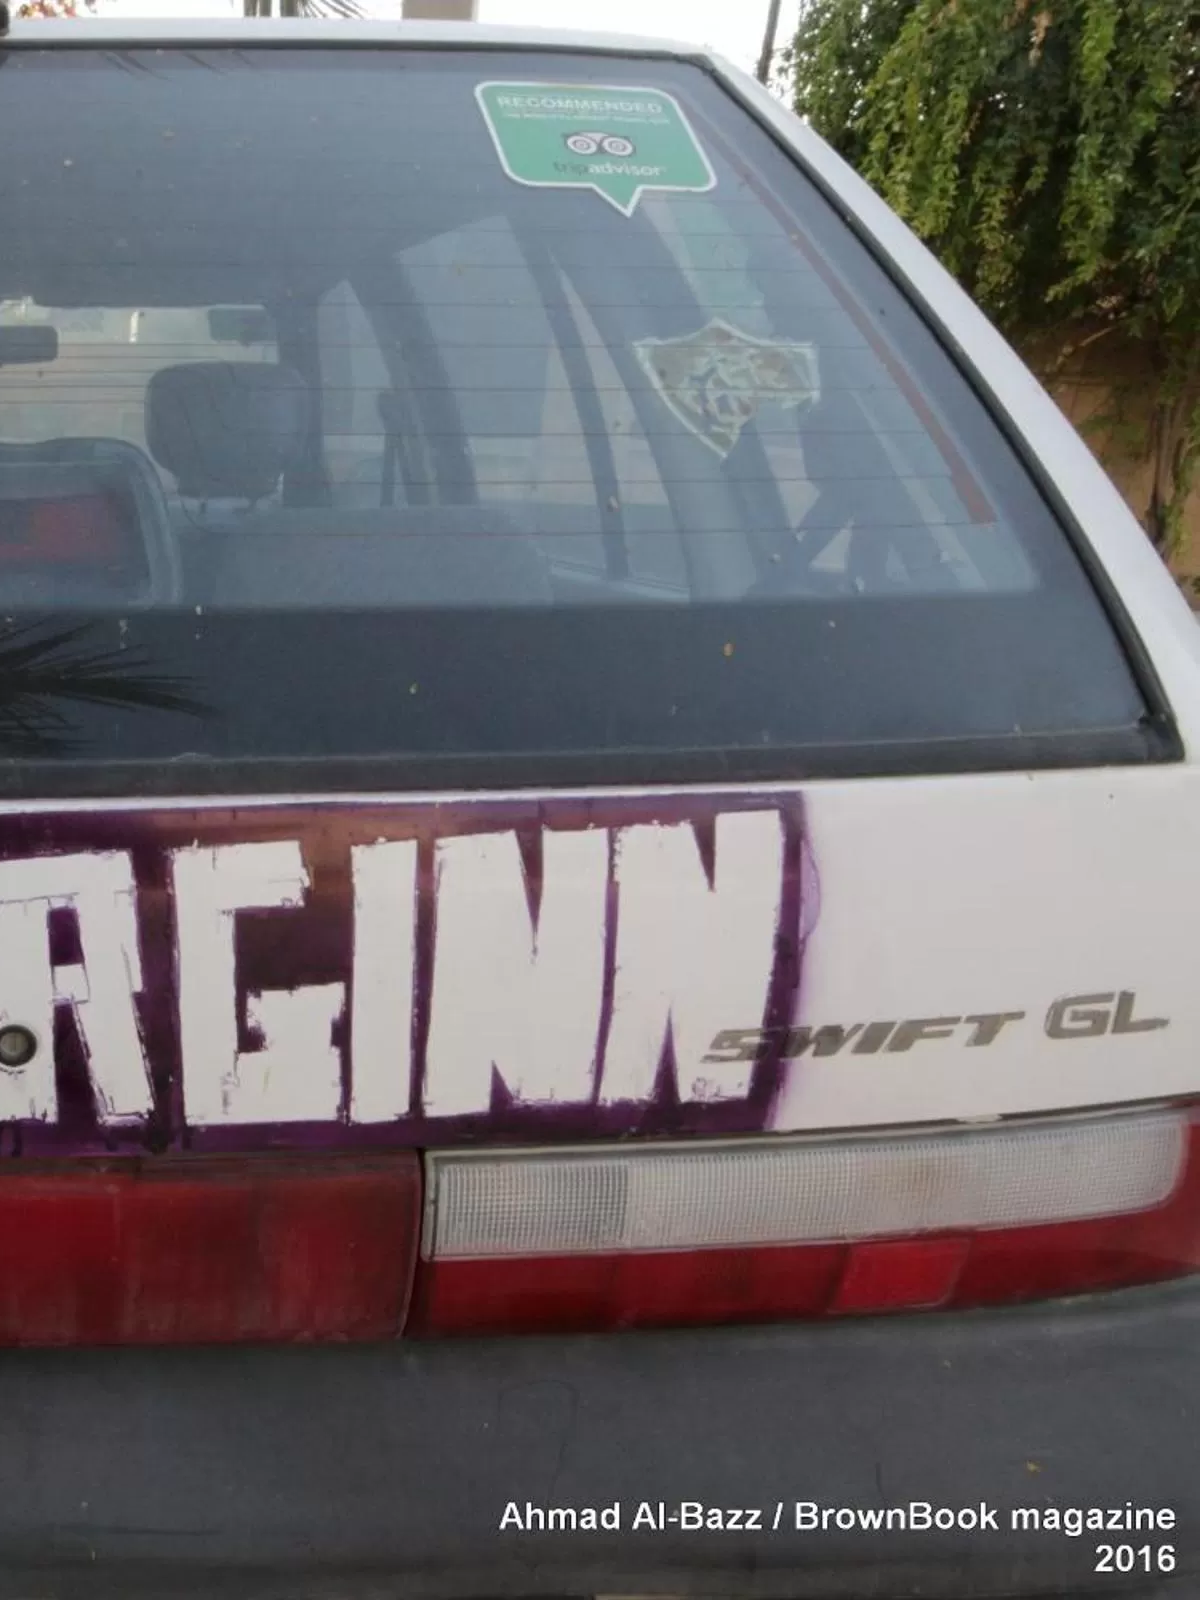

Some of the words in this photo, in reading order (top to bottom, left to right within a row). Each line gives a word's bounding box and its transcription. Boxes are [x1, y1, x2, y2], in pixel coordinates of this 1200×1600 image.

[496, 95, 663, 114] RECOMMENDED
[701, 1010, 1025, 1063] SWIFT
[1044, 990, 1170, 1040] GL
